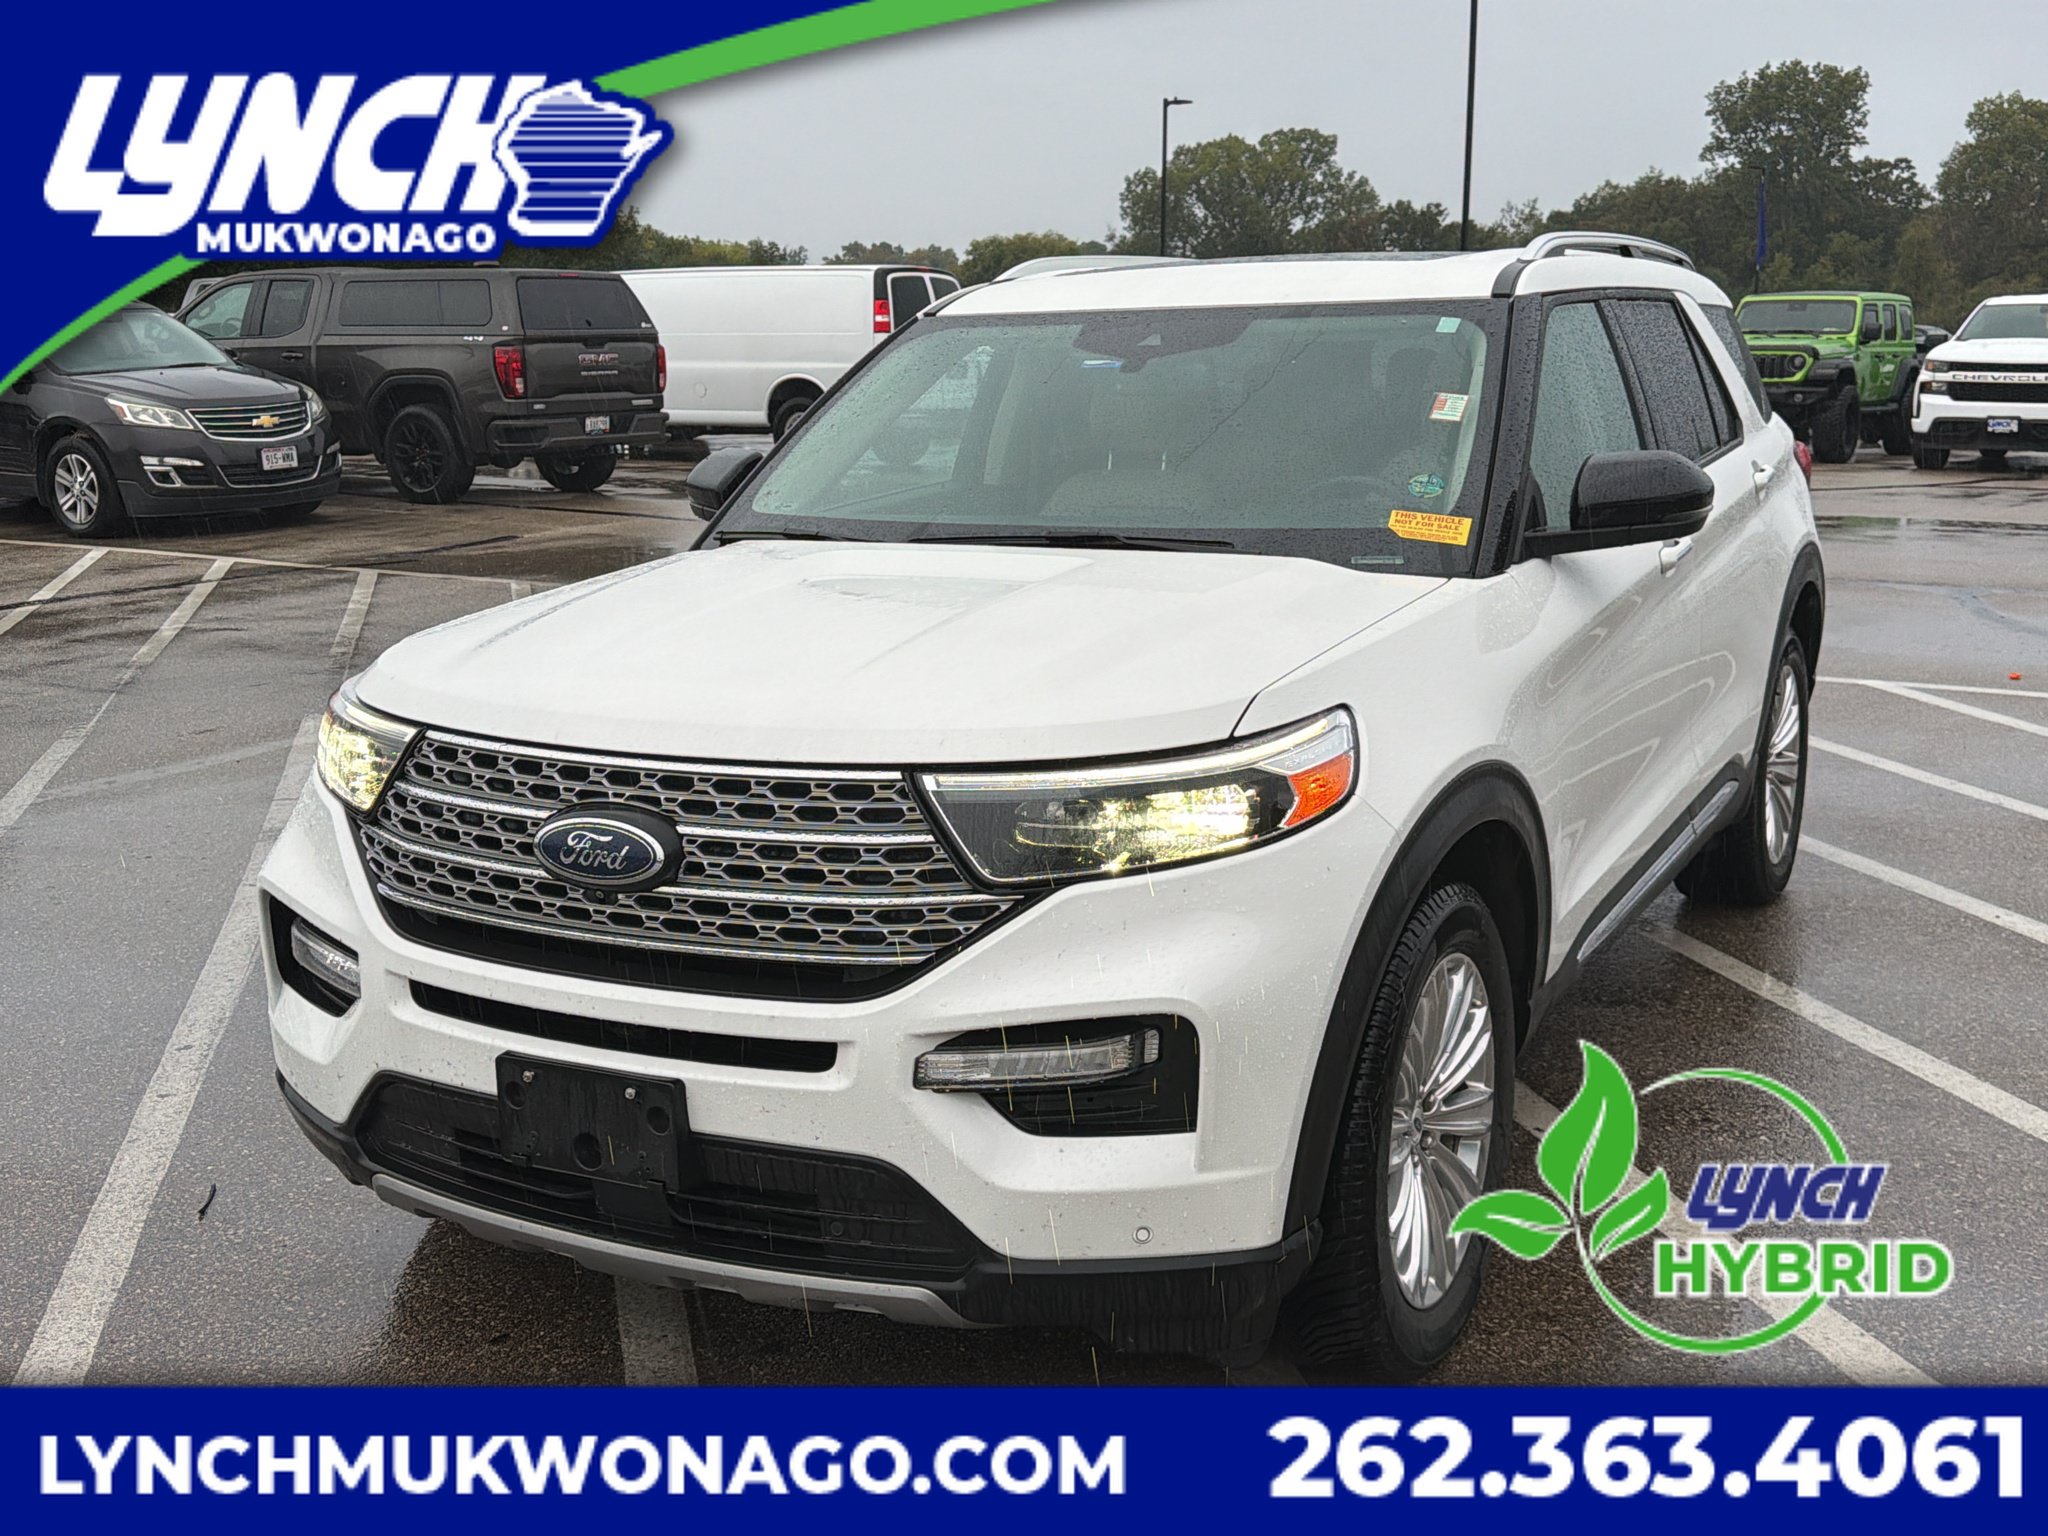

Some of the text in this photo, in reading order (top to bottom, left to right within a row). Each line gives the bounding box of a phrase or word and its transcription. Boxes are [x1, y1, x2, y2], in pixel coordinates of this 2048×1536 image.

[1394, 511, 1465, 525] THIS VEHICLE
[1437, 523, 1461, 531] SALE
[559, 830, 630, 870] Ford
